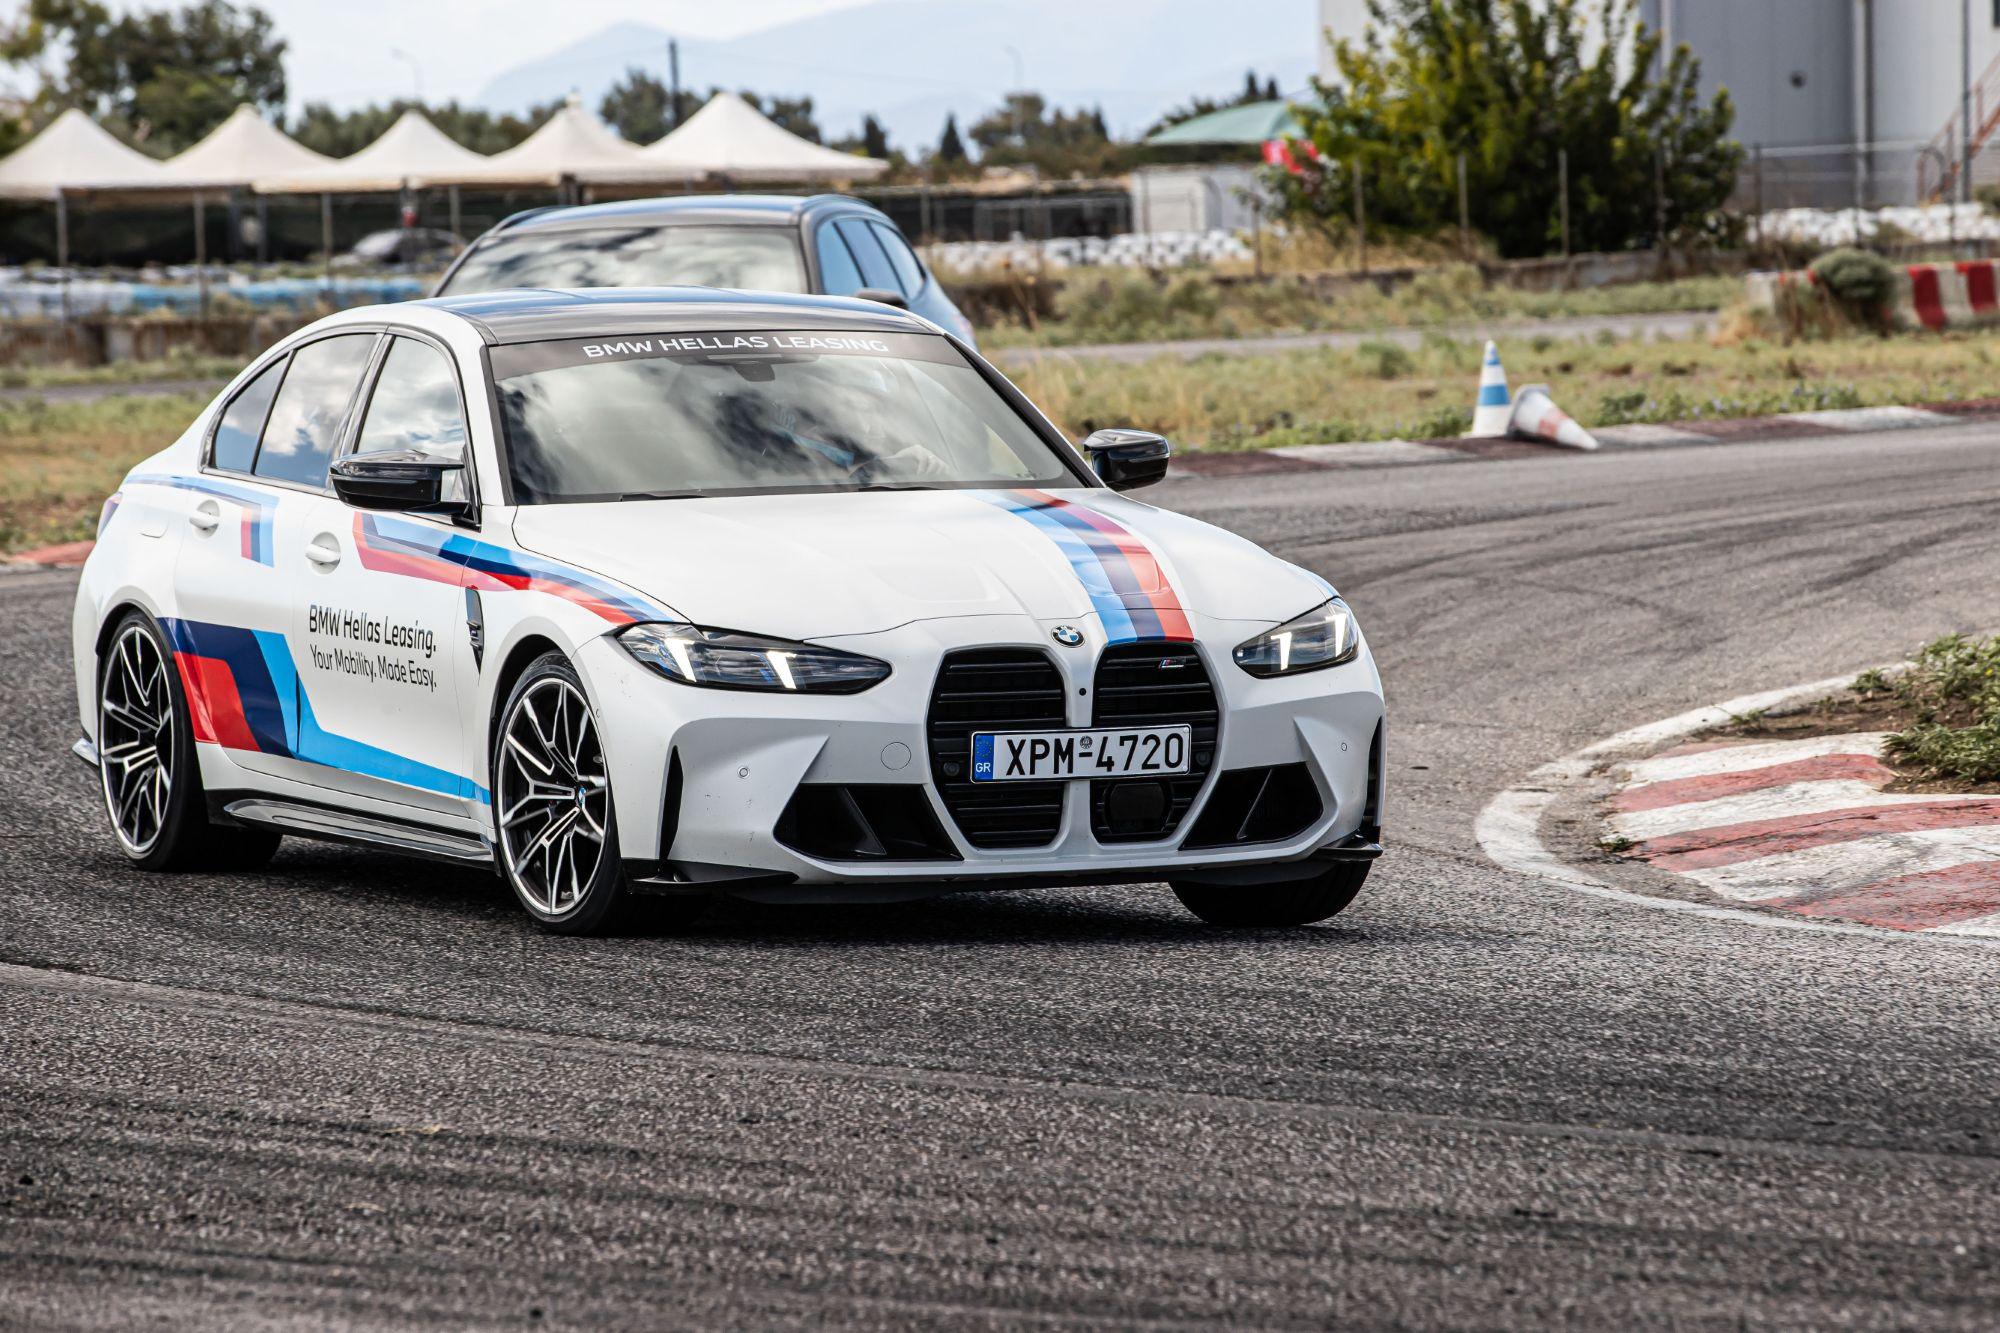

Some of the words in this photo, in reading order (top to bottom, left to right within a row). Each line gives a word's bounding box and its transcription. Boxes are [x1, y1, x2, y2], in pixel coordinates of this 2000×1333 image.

[582, 340, 653, 358] BMW
[658, 336, 769, 351] HELLAS
[772, 336, 889, 352] LEASING
[309, 604, 342, 637] BMW
[343, 609, 381, 643] Hellas
[384, 615, 437, 659] Leasing.
[309, 643, 333, 671] Your
[334, 648, 377, 683] Mobility.
[377, 655, 408, 683] Made
[408, 659, 437, 693] Easy.
[975, 762, 991, 773] GR
